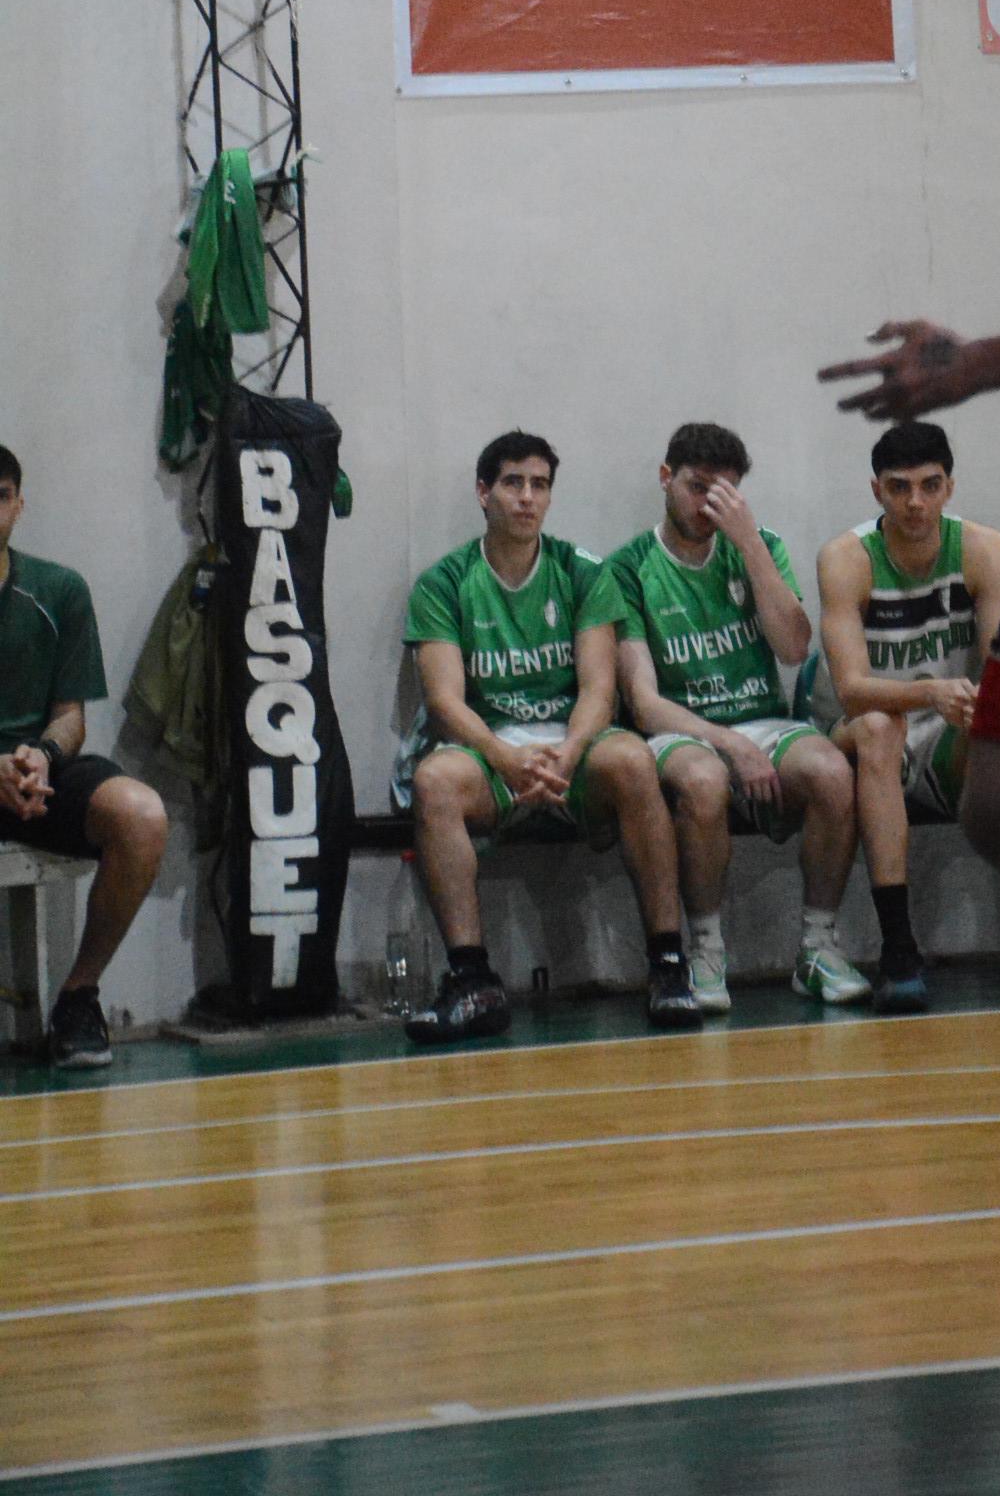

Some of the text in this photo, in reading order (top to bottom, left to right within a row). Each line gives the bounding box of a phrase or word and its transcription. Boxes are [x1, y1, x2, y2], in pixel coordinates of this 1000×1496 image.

[663, 615, 761, 665] JUVENTU
[865, 621, 977, 671] UVENTUD
[238, 446, 321, 990] BASQUET
